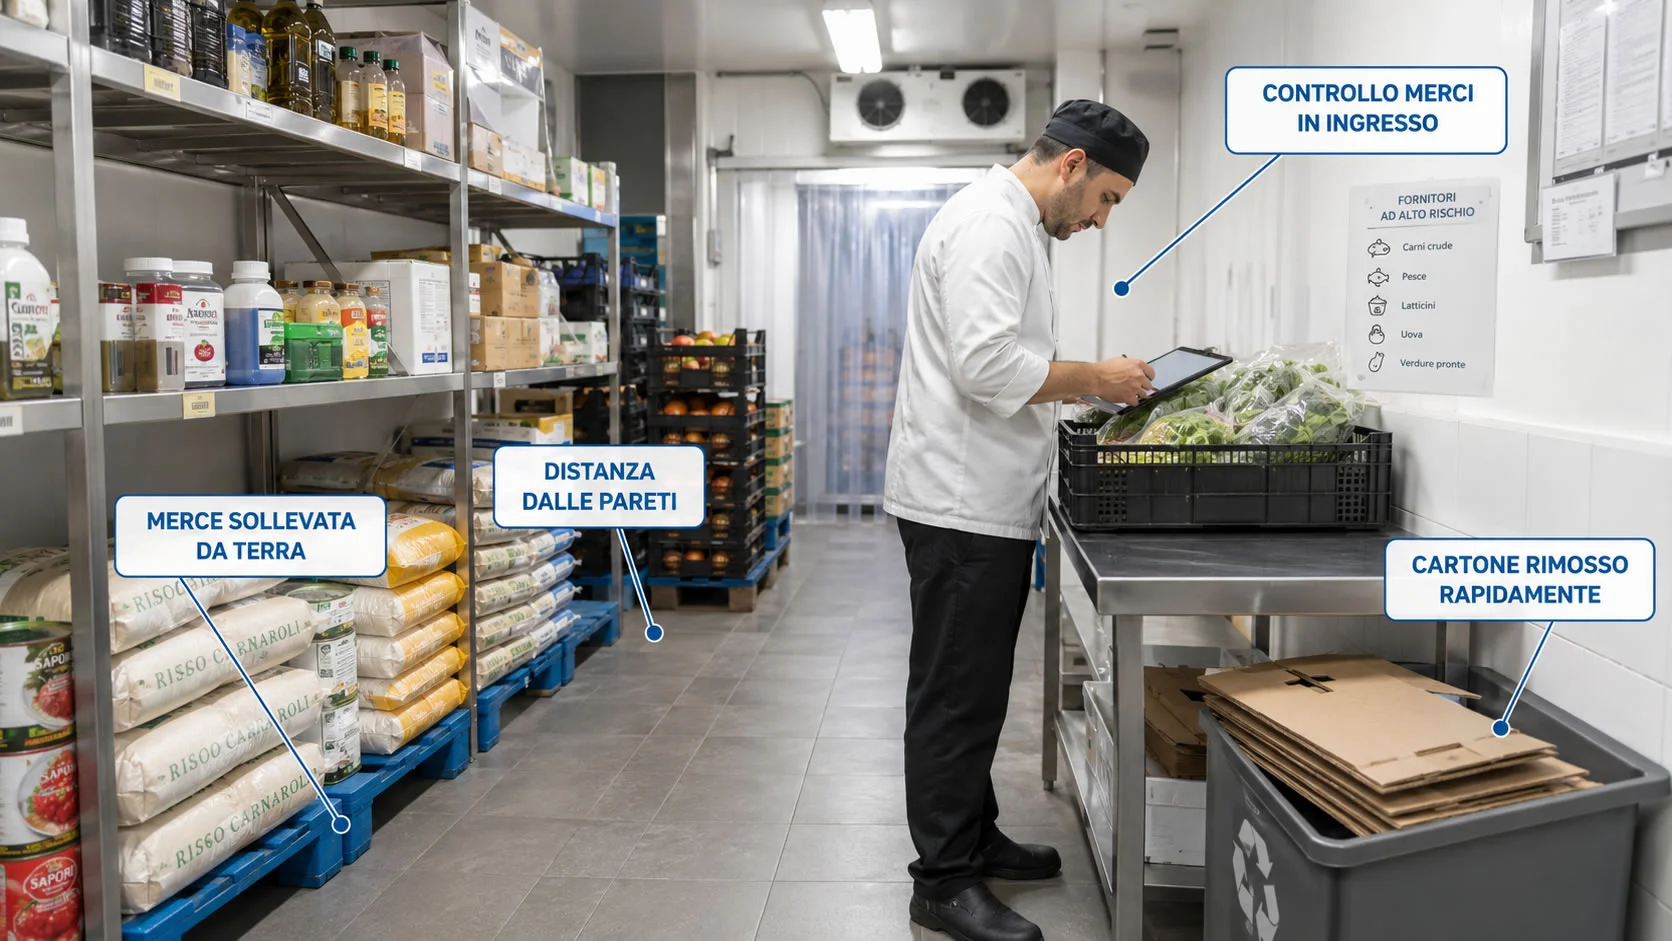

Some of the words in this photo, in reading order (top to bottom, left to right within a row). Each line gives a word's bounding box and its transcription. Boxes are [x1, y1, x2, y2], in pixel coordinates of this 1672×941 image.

[1398, 192, 1456, 205] FORNITORI
[1380, 211, 1396, 221] AD
[1398, 209, 1427, 220] ALTO
[1429, 206, 1475, 219] RISCHIO
[1402, 242, 1426, 252] Carni
[1427, 241, 1453, 251] crude
[1402, 272, 1427, 281] Pesce
[1401, 301, 1436, 310] Latticini
[1400, 330, 1423, 339] Uova
[1400, 359, 1435, 368] Verdure
[1436, 361, 1466, 370] pronte
[212, 619, 300, 664] CRNAROLI
